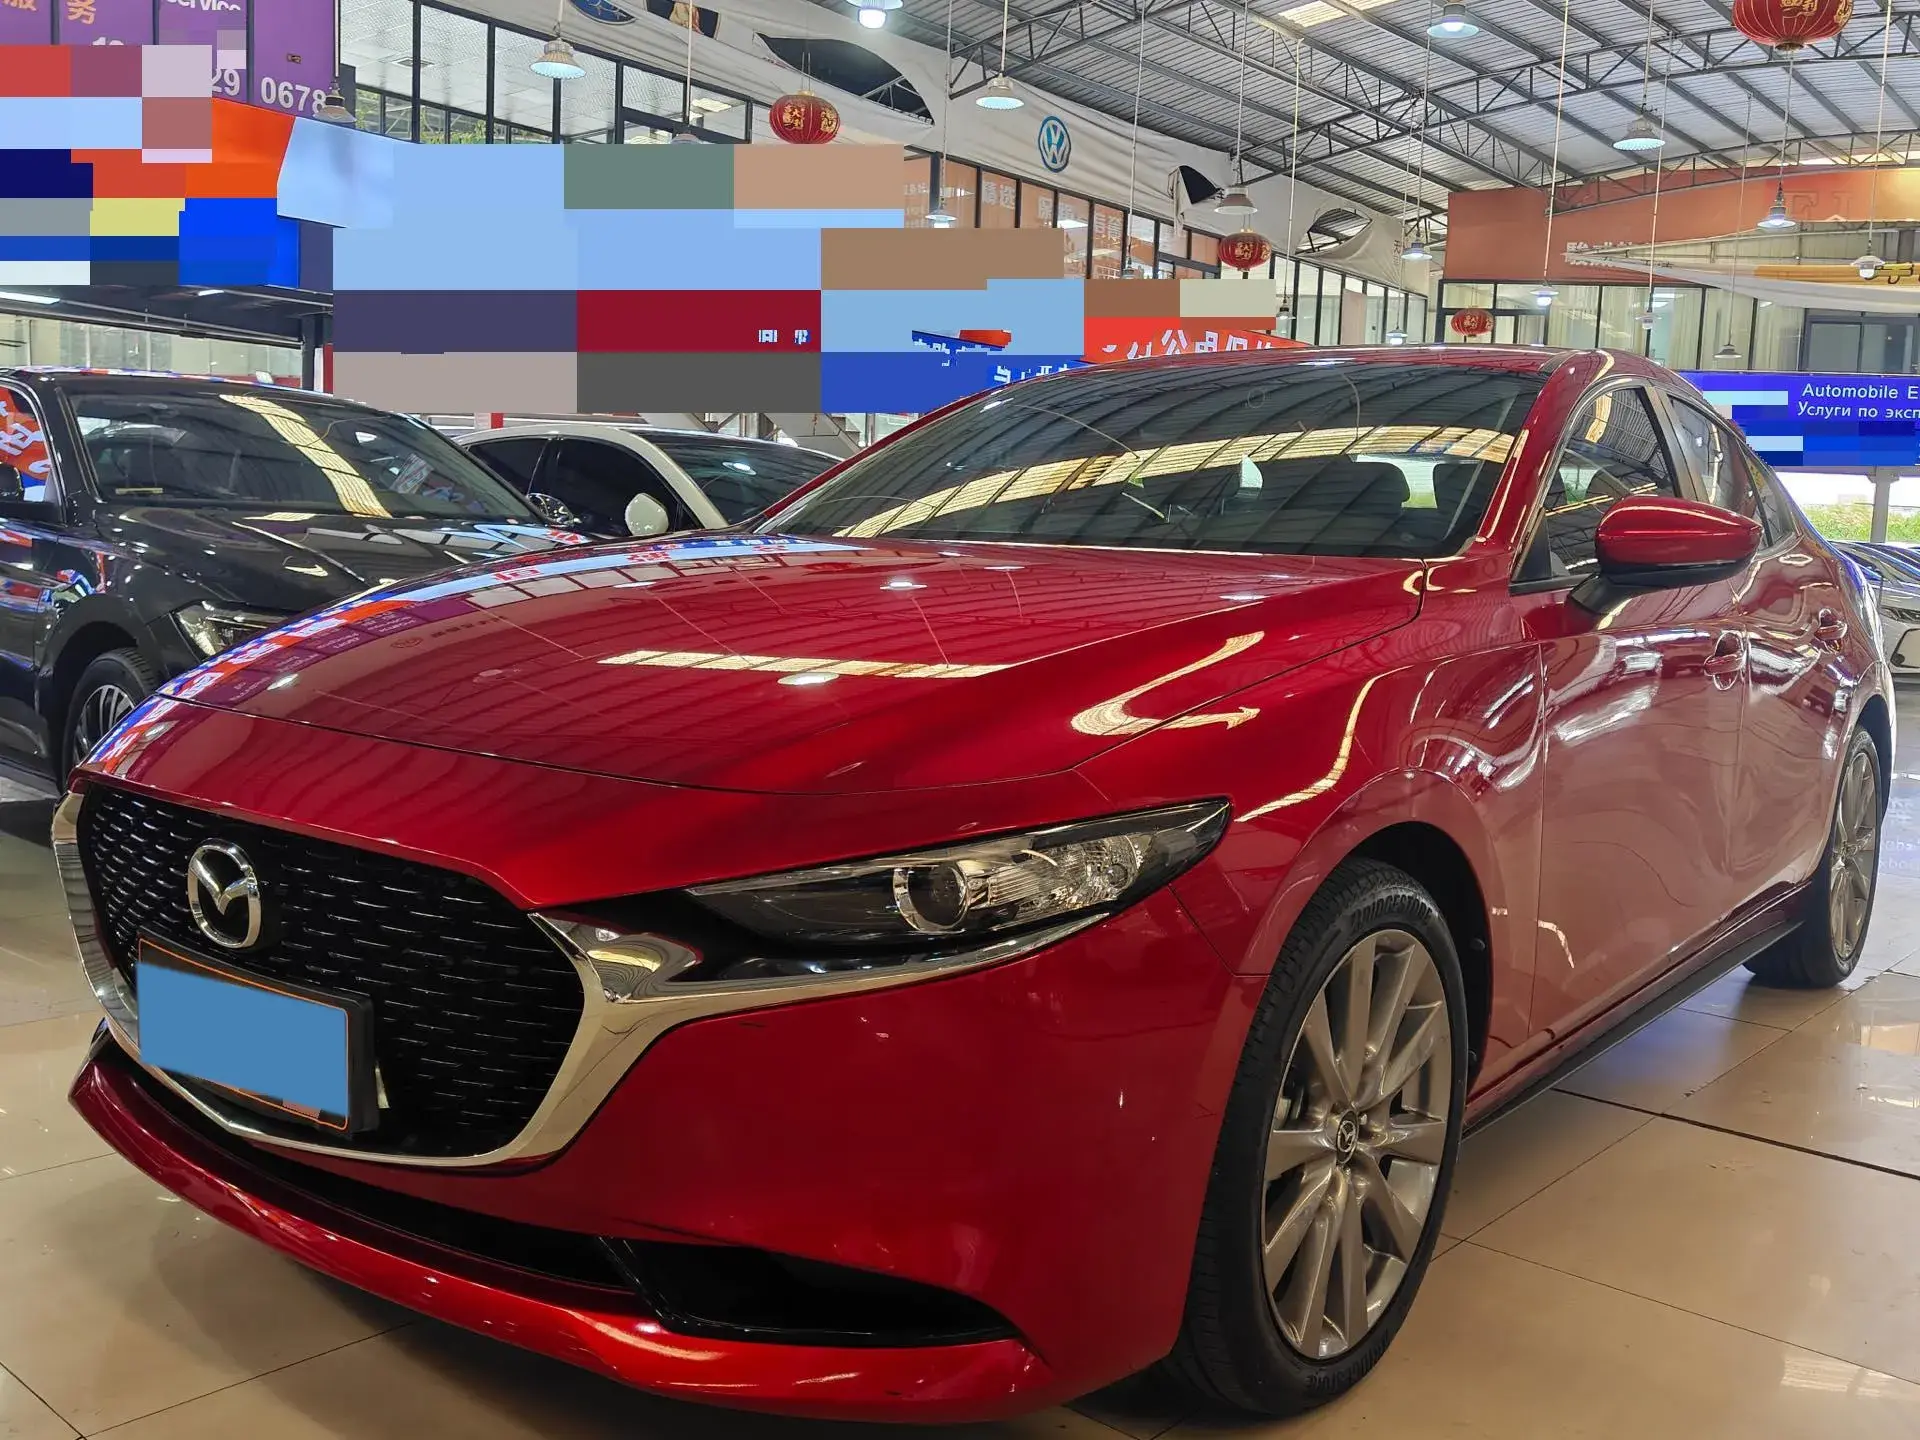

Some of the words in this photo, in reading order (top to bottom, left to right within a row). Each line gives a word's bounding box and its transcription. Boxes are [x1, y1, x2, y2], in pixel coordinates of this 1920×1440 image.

[261, 77, 327, 113] 0678
[1802, 383, 1898, 398] Automobile
[1798, 401, 1851, 419] Услуги
[1858, 407, 1878, 417] по
